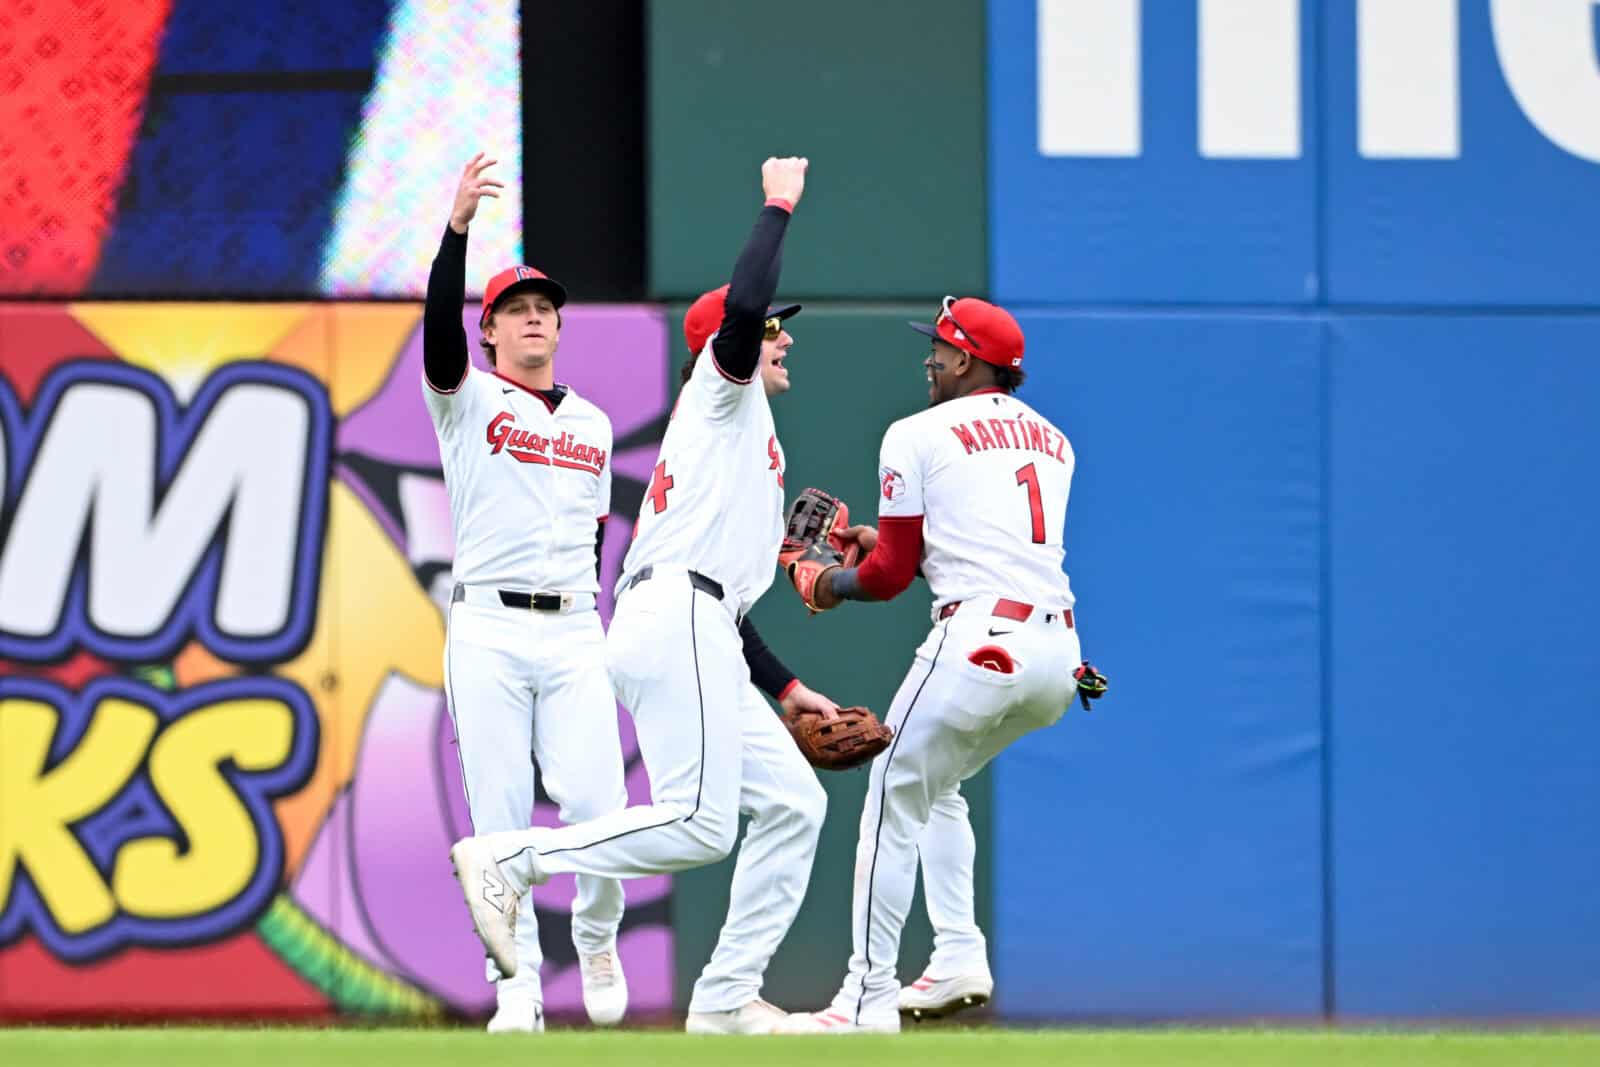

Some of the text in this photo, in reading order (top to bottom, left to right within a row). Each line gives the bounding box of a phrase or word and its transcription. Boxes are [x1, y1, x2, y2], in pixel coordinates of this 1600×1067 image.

[486, 410, 607, 471] Guardians
[950, 412, 1066, 465] MARTÍNEZ
[1015, 461, 1046, 545] 1
